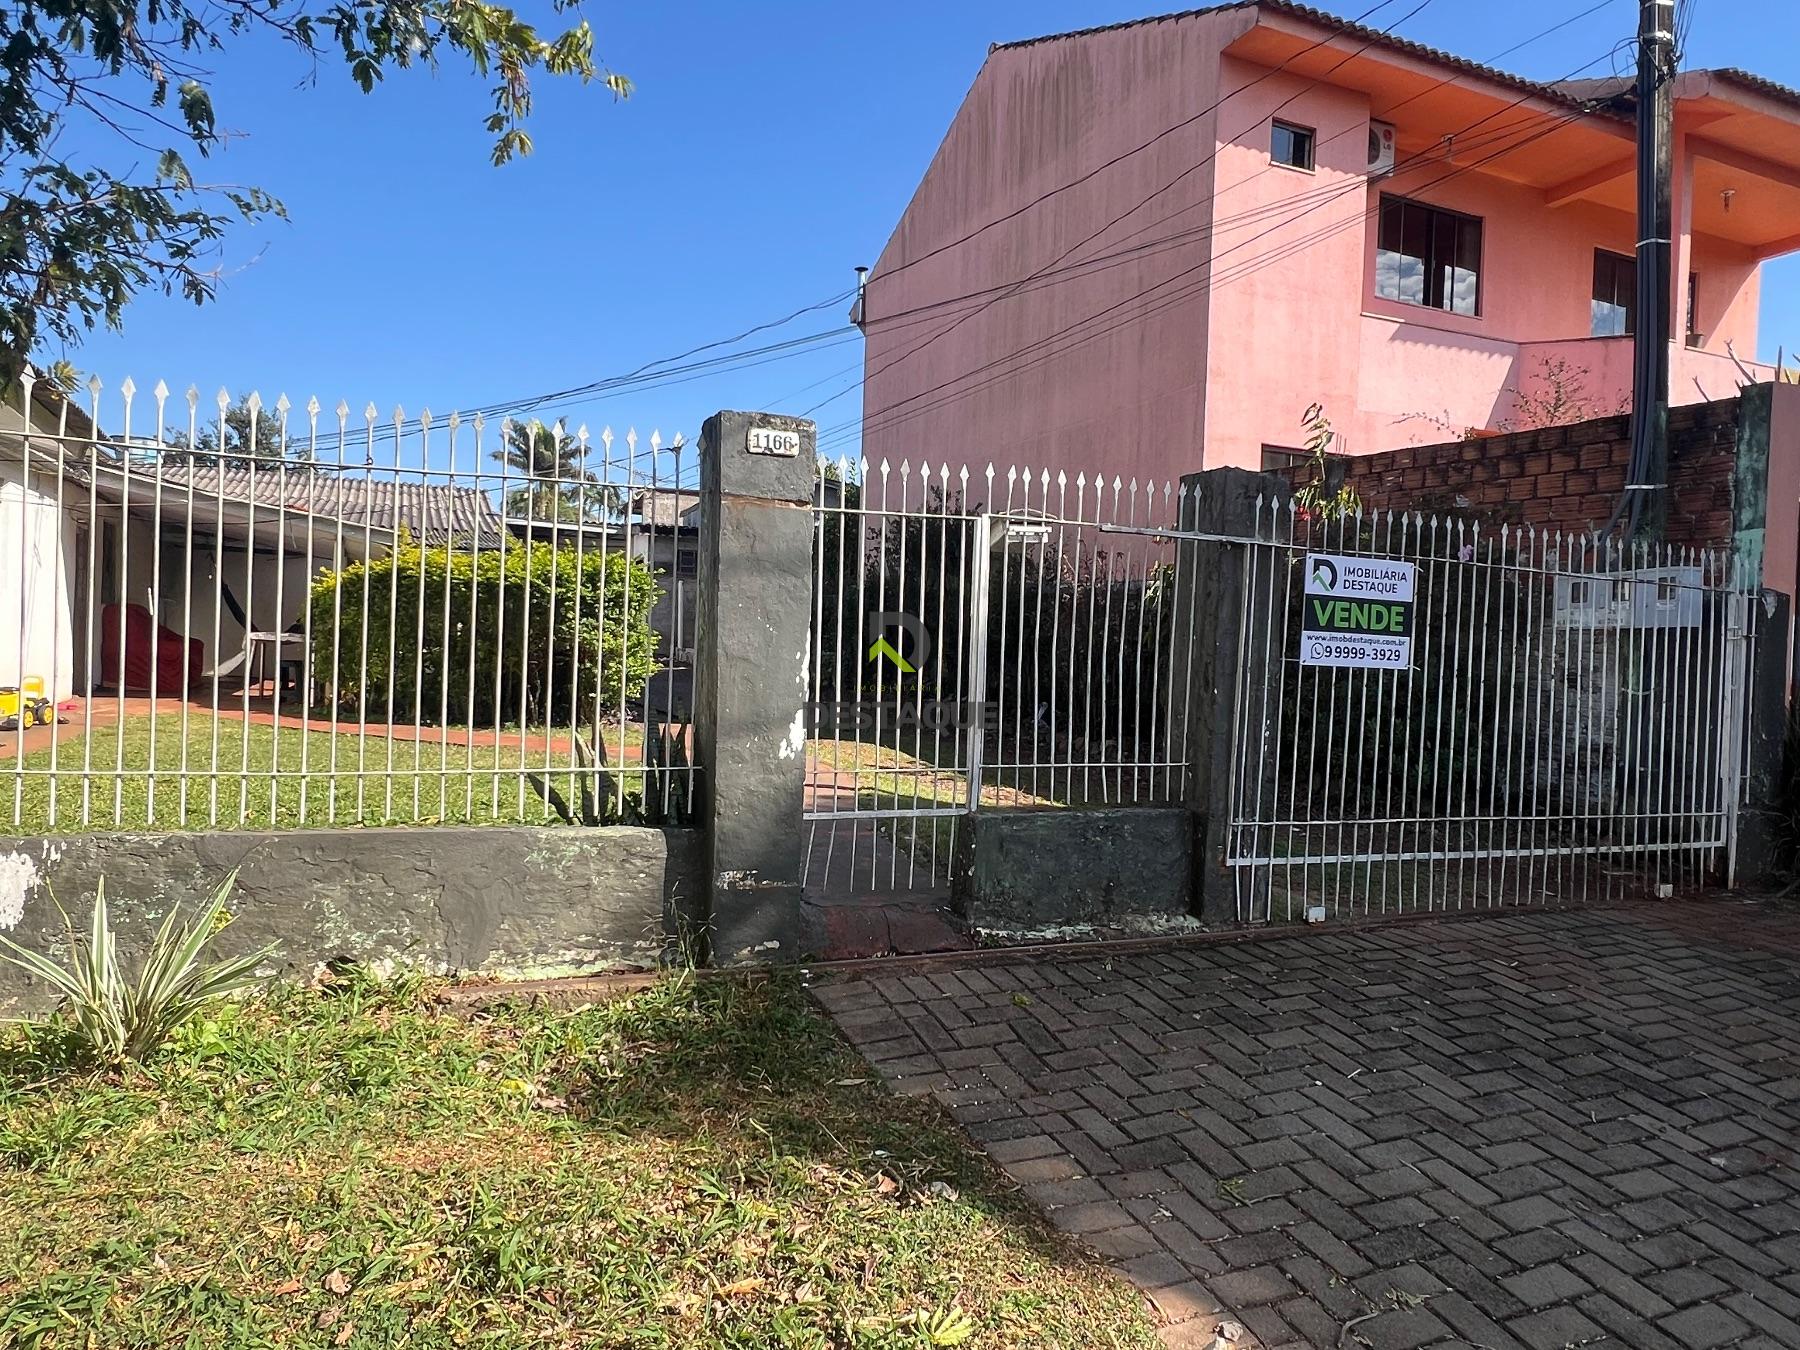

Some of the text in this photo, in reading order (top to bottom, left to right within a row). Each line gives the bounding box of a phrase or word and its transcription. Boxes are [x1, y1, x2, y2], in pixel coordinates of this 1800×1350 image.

[752, 433, 794, 451] 1166
[1344, 566, 1408, 582] IMOBILIÁRIA
[1343, 579, 1398, 594] DESTAQUE
[1313, 599, 1405, 632] VENDE
